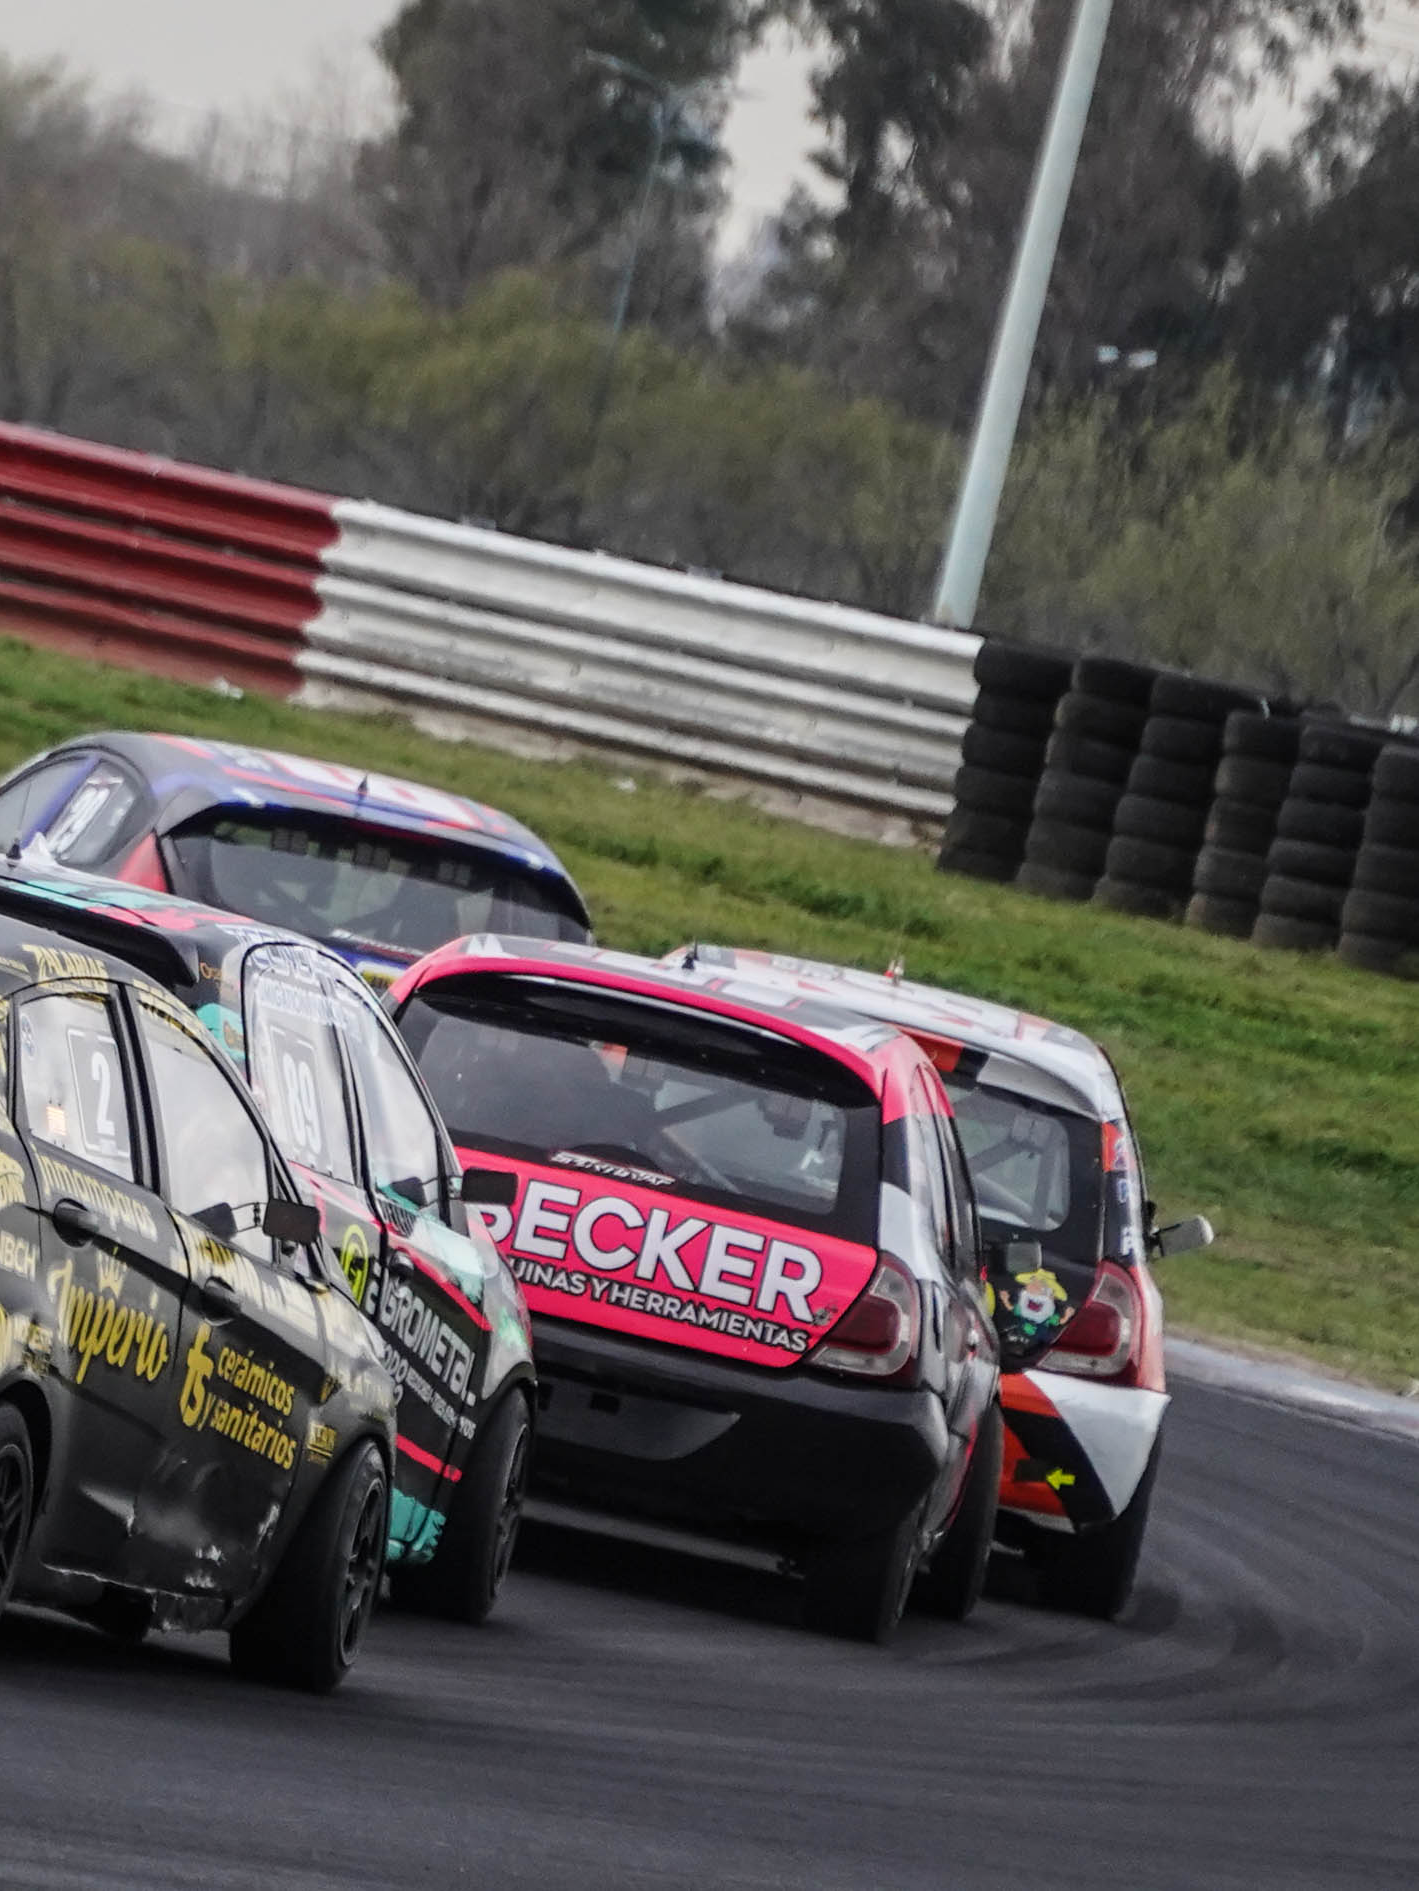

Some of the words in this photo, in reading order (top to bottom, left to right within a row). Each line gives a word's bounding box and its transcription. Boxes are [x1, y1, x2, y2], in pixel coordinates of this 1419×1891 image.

[90, 1051, 117, 1136] 2
[282, 1052, 323, 1154] 89
[508, 1256, 588, 1296] UINAS
[590, 1277, 611, 1301] Y
[610, 1282, 810, 1352] HERRAMIENTAS
[217, 1346, 295, 1417] cerámicos
[209, 1398, 298, 1471] sanitarios
